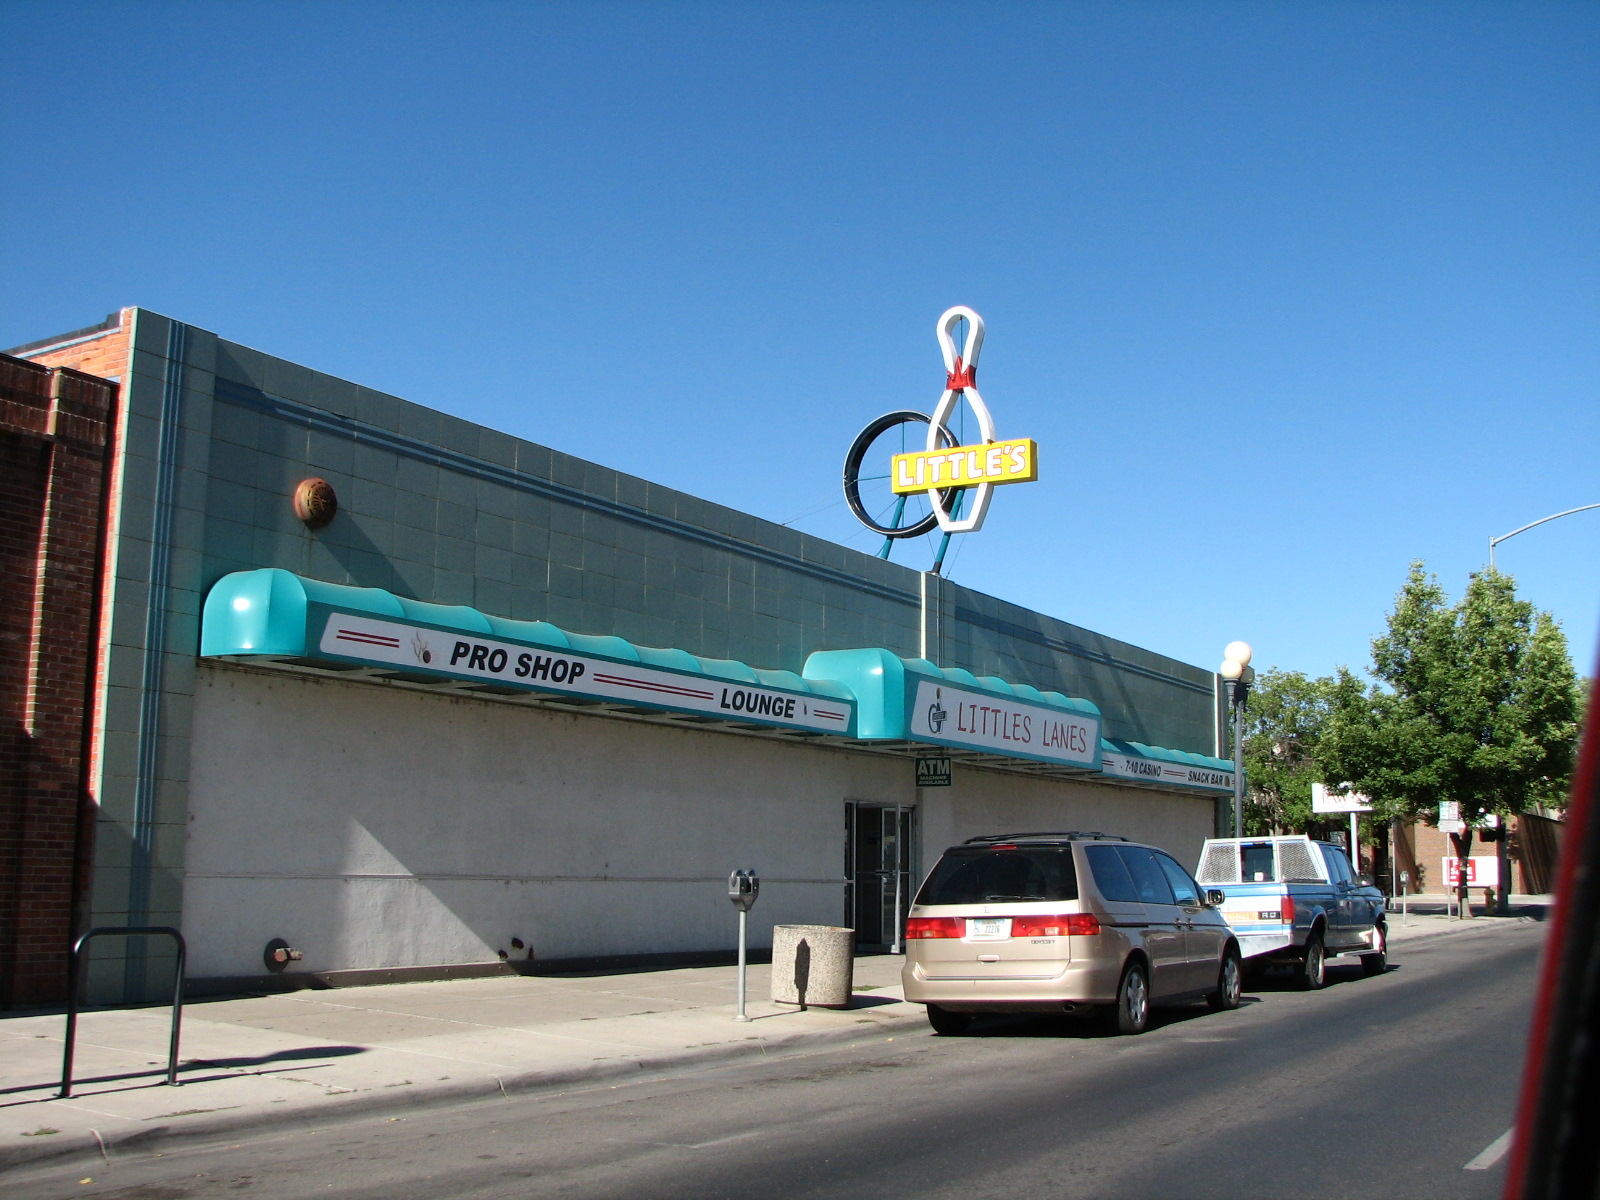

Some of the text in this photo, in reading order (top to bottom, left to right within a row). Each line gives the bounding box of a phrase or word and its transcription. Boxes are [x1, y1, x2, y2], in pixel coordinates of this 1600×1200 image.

[897, 445, 1026, 487] LITTLE'S
[450, 641, 585, 685] PRO SHOP
[720, 688, 796, 718] LOUNGE
[957, 702, 1087, 753] LITTLES LANES
[917, 759, 950, 775] ATM
[1139, 763, 1161, 777] CASINO
[1188, 770, 1223, 786] SNACK BAR
